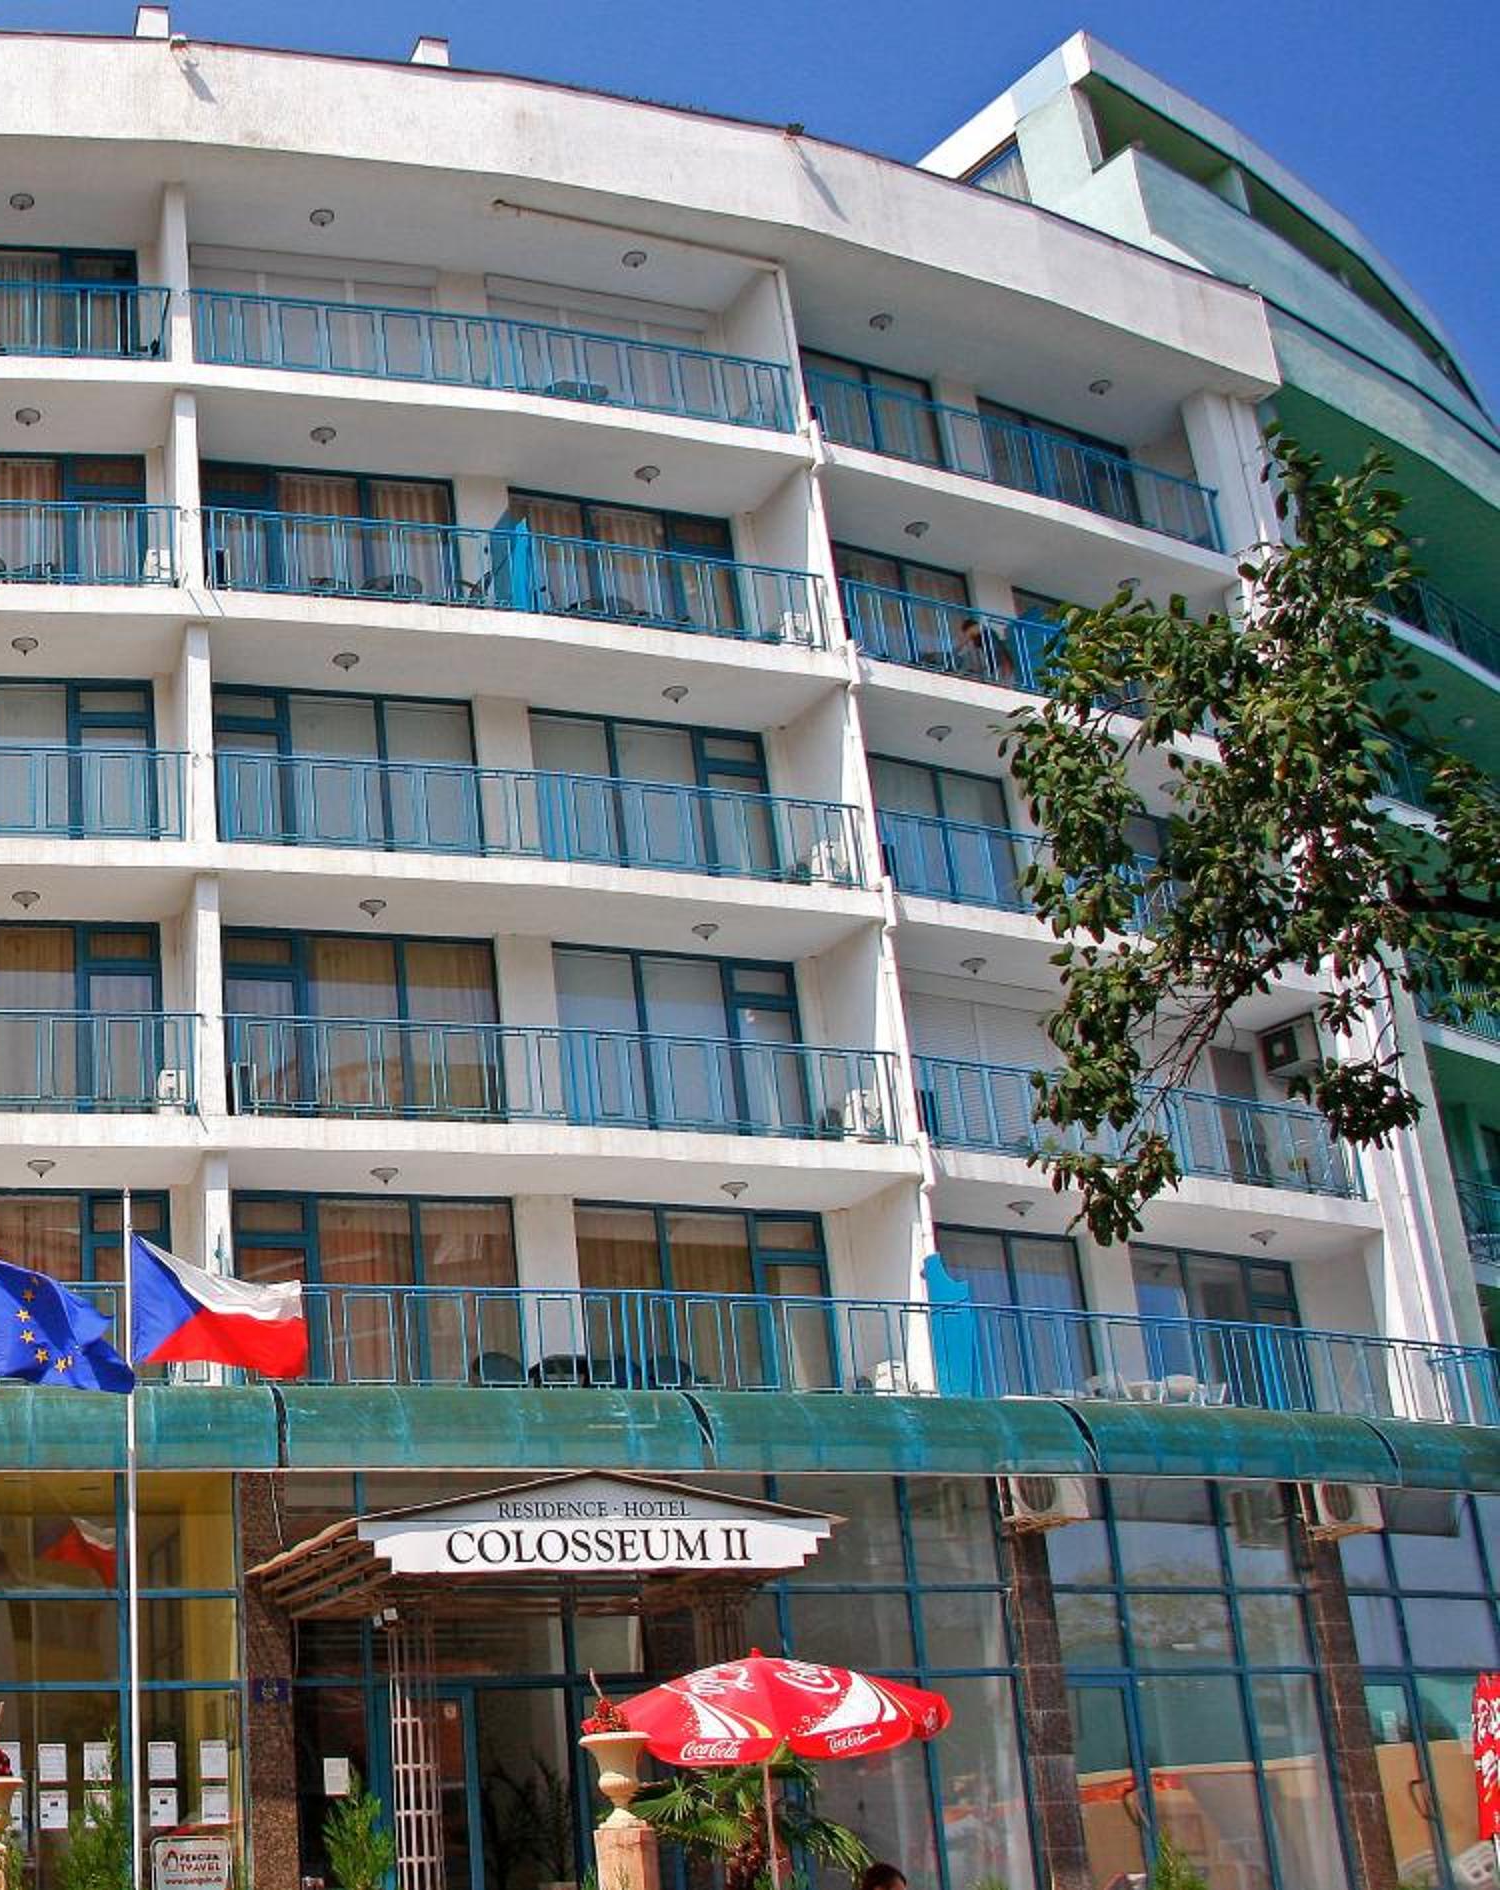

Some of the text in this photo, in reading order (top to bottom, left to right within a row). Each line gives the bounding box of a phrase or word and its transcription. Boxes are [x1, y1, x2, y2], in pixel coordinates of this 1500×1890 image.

[498, 1500, 691, 1518] RESIDENCE HOTEL
[446, 1528, 752, 1564] COLOSSEUM II
